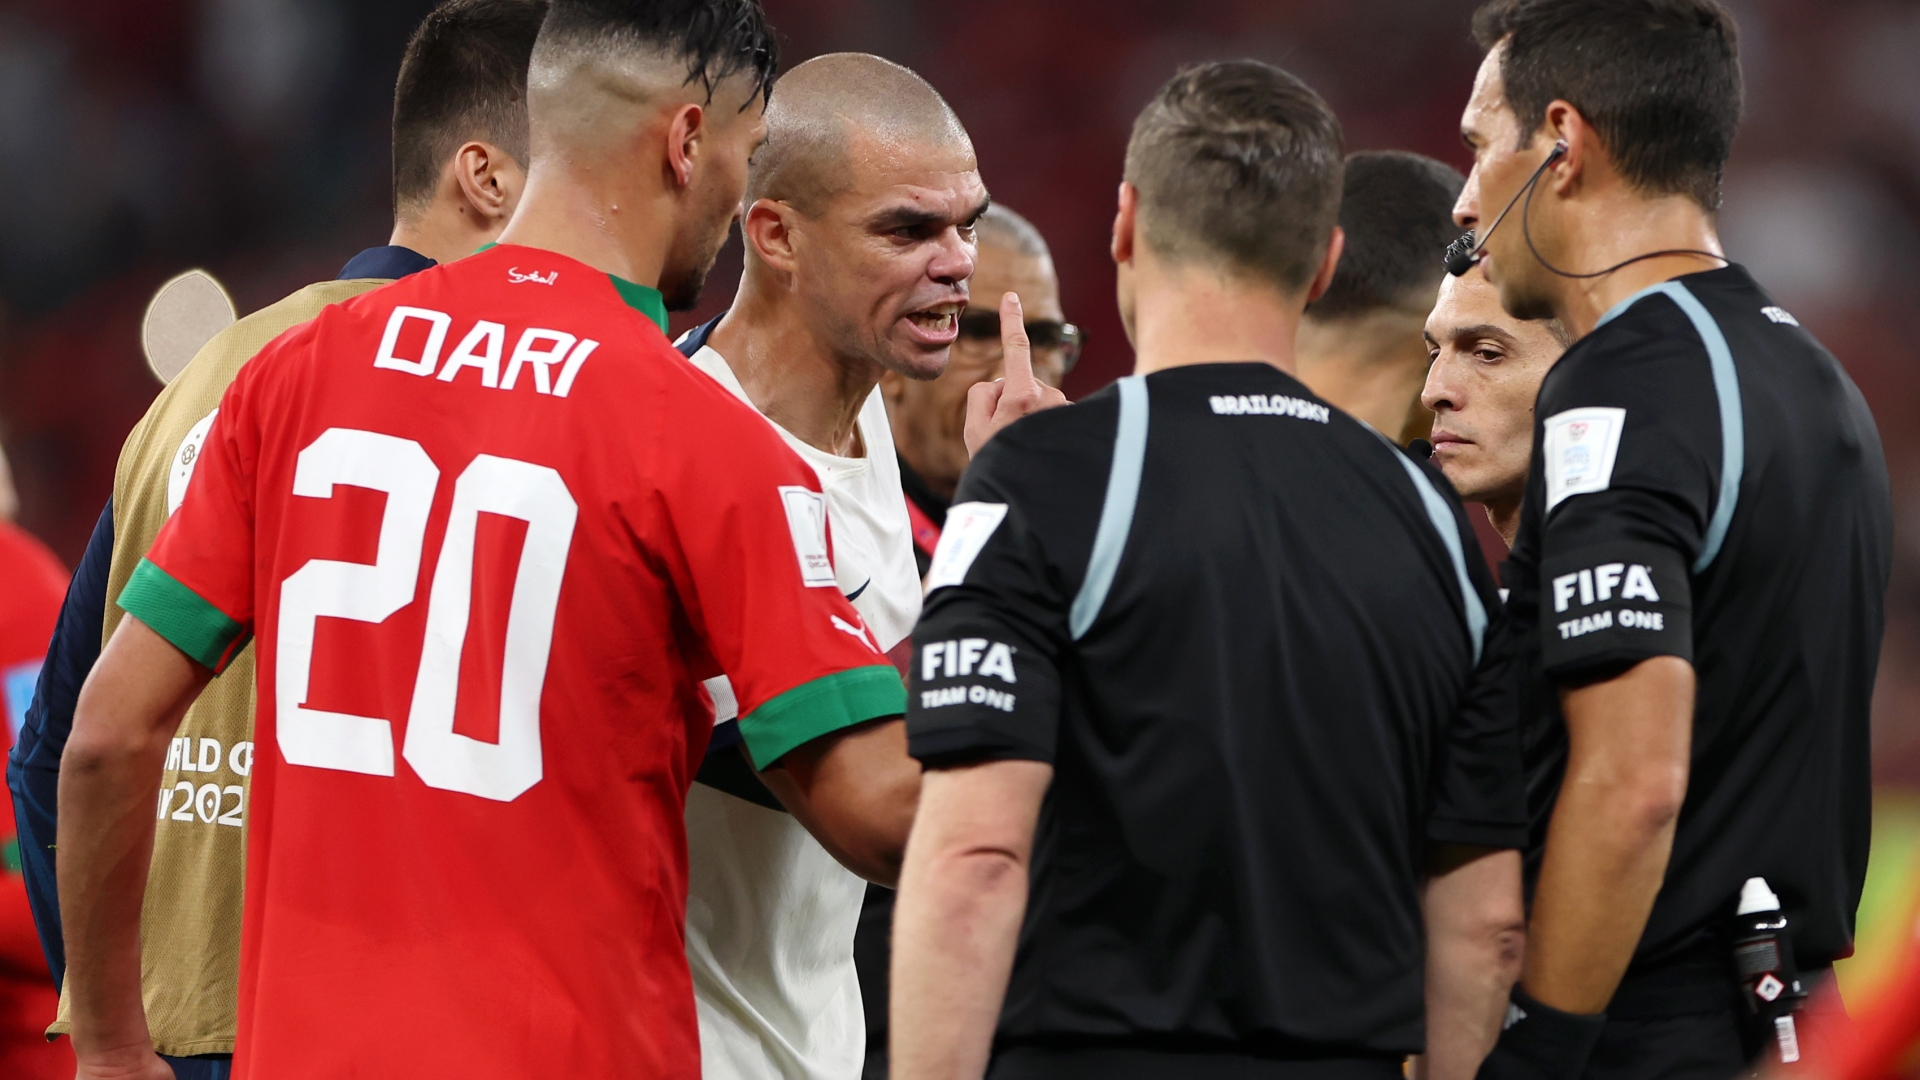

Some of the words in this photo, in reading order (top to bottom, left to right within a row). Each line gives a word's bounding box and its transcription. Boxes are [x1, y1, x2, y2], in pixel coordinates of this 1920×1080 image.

[374, 305, 599, 398] DARI
[1208, 394, 1330, 424] BRAILOVSKY
[1552, 562, 1660, 613] FIFA
[276, 427, 579, 803] 20
[1557, 610, 1613, 640] TEAM
[1618, 608, 1664, 631] ONE
[921, 637, 1017, 684] FIFA
[920, 685, 967, 709] TEAM
[968, 684, 1016, 713] ONE
[164, 736, 222, 774] RLD
